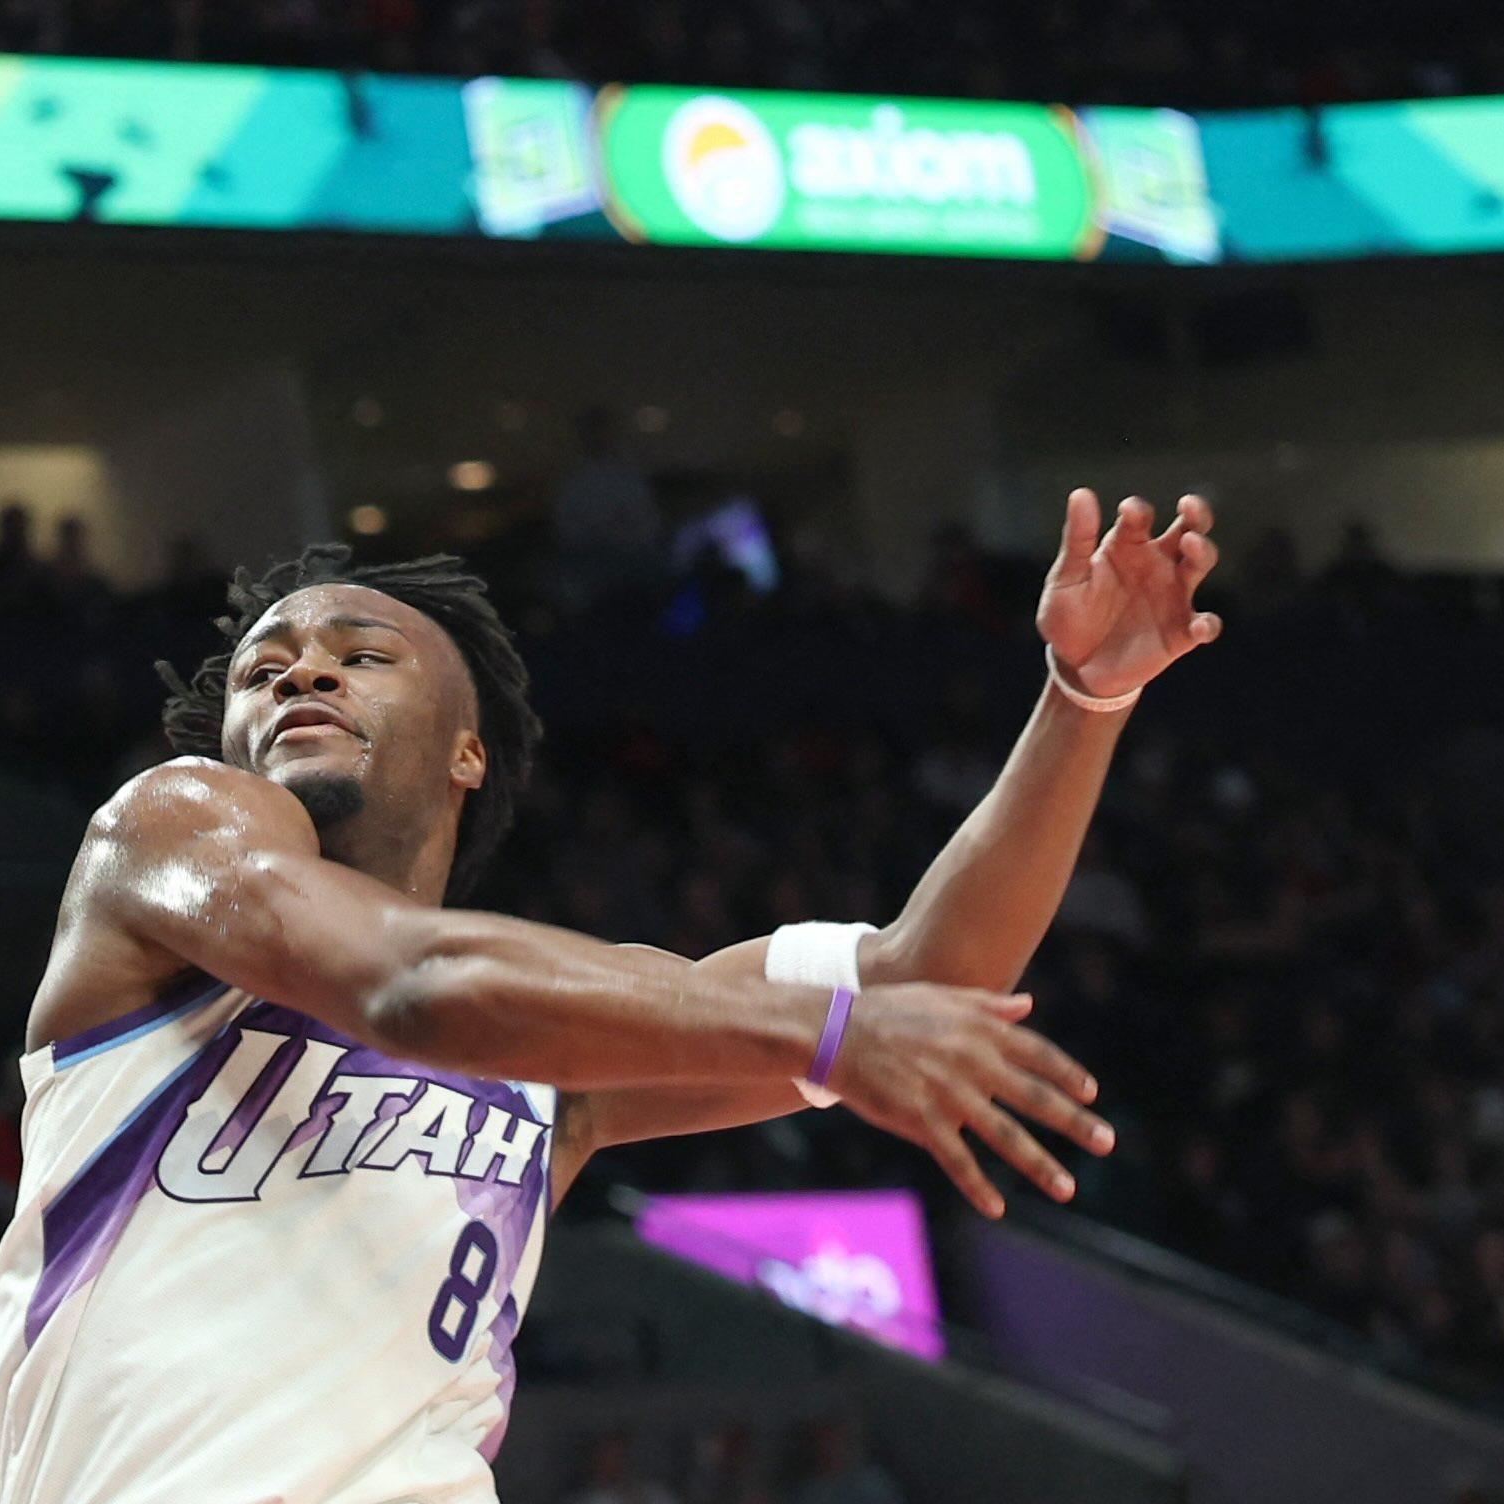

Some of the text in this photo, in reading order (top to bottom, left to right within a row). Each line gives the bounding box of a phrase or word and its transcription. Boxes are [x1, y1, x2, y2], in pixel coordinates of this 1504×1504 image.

[787, 104, 1036, 205] axiom
[155, 1028, 552, 1203] UTAH
[428, 1219, 498, 1364] 8
